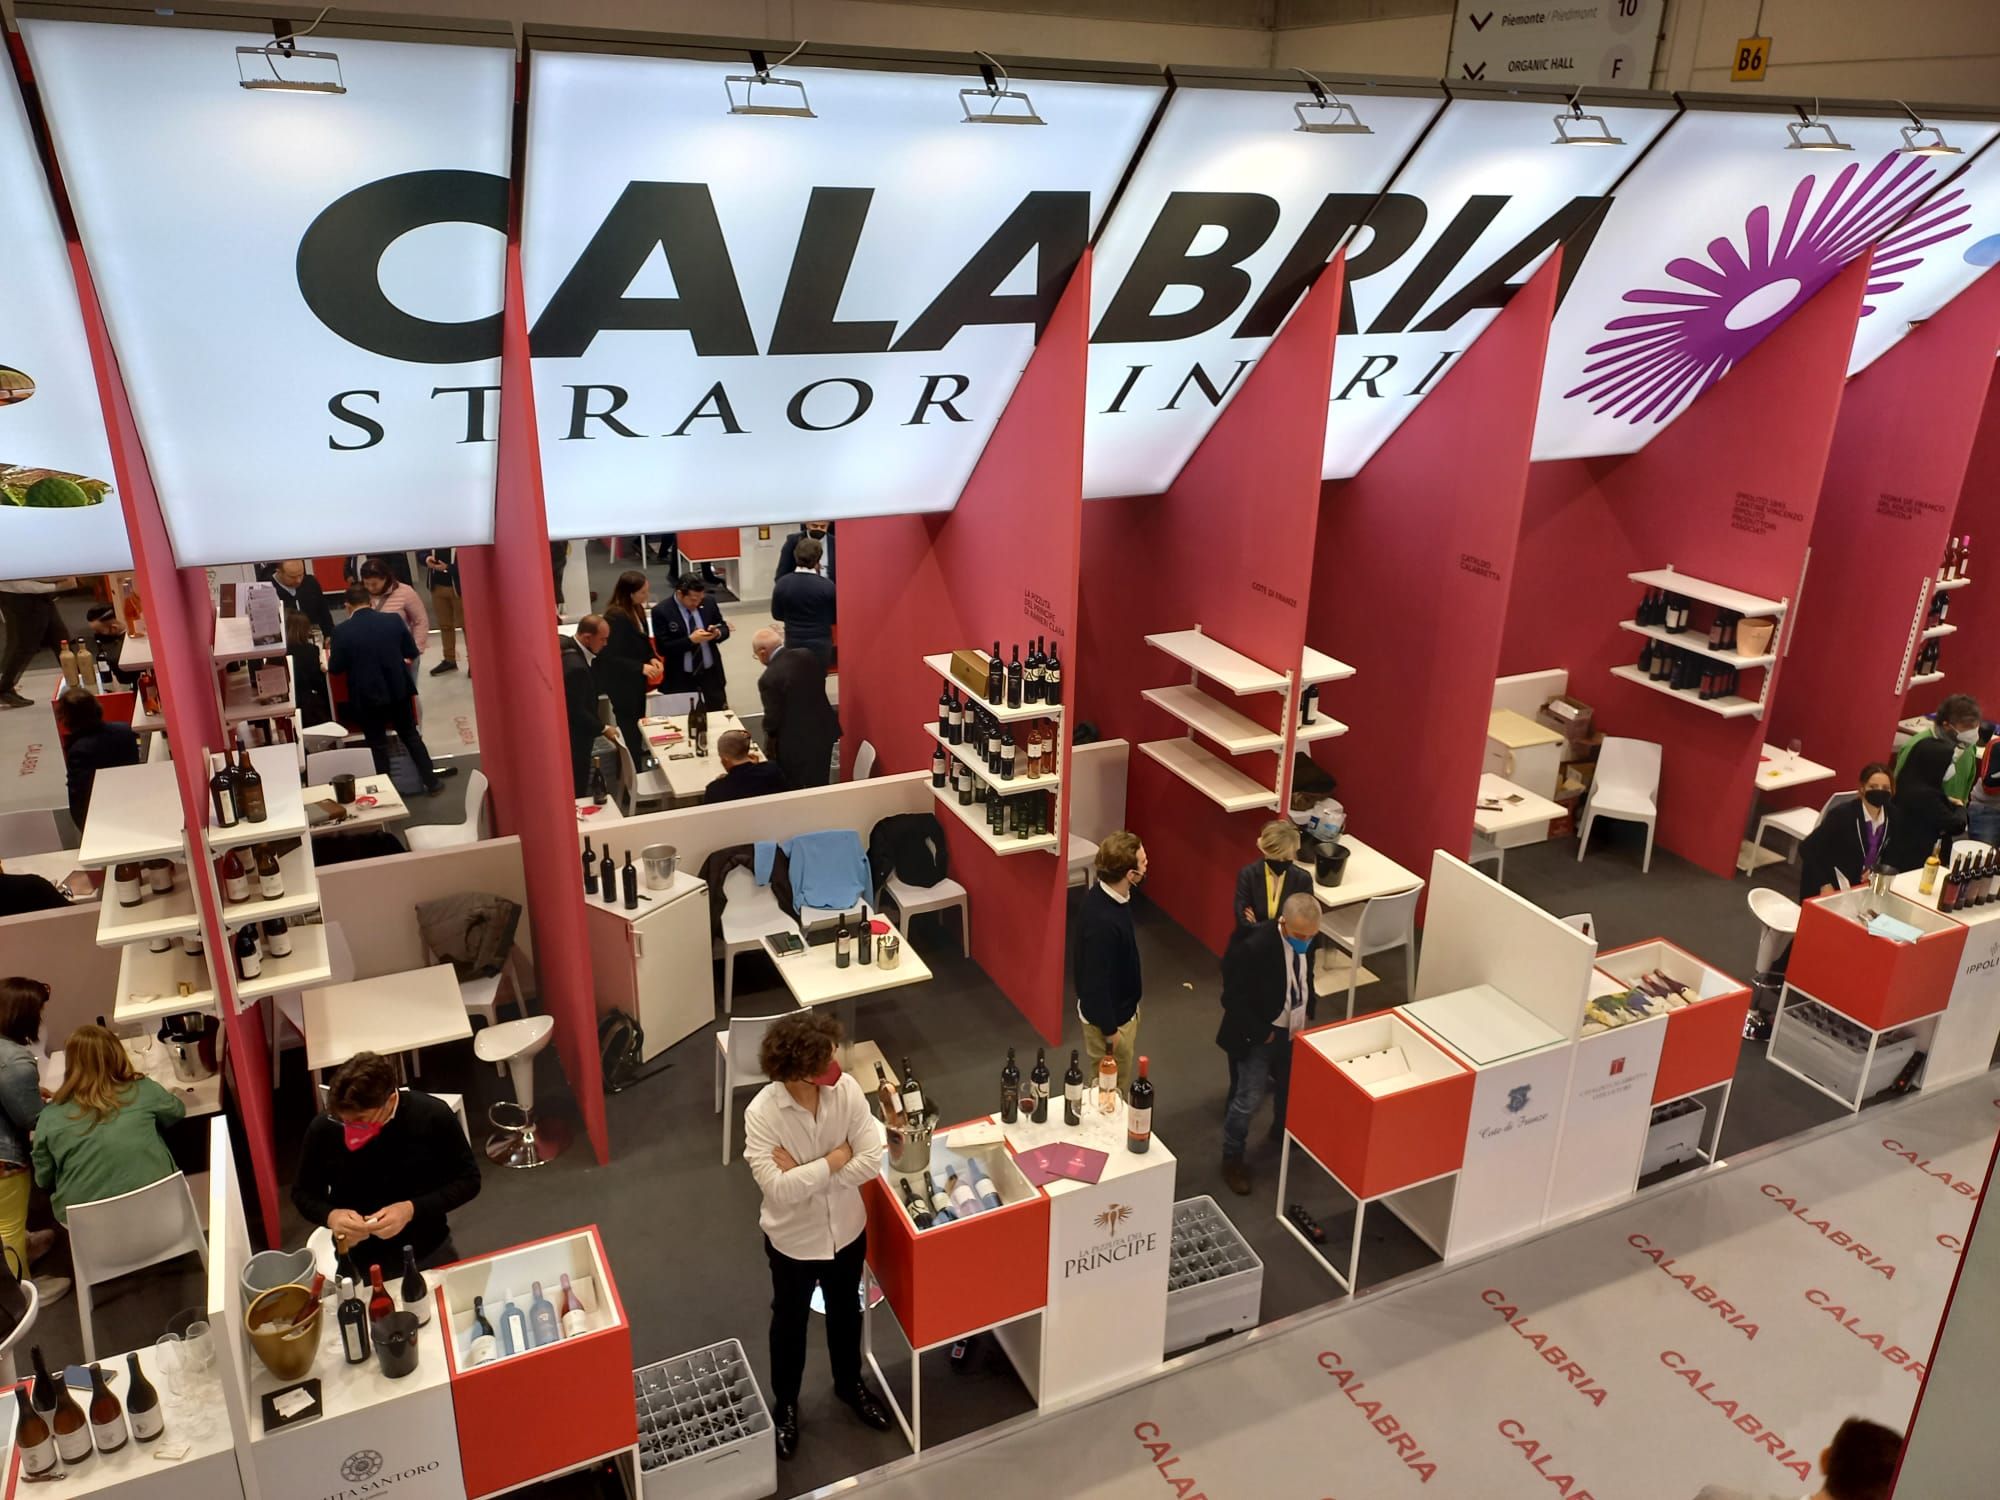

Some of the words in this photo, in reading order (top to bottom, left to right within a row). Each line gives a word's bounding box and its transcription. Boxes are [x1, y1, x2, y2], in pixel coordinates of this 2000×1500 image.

[1501, 12, 1545, 26] Piemonte
[1551, 8, 1598, 21] Piedmont
[1618, 0, 1637, 17] 10
[1737, 48, 1762, 73] B6
[1508, 59, 1549, 72] ORGANIC
[1551, 57, 1574, 69] HALL
[1611, 59, 1623, 79] F
[296, 169, 1615, 364] CALABRIA
[327, 350, 1462, 450] STRAORINRI
[1064, 1232, 1157, 1279] PRINCIPE
[1761, 1184, 1896, 1280] CALABRIA
[1628, 1233, 1760, 1341] CALABRIA
[1482, 1288, 1608, 1407] CALABRIA
[1805, 1289, 1927, 1382] CALABR
[1318, 1351, 1438, 1484] CALABRIA
[1660, 1350, 1812, 1482] CALABRIA
[360, 1460, 440, 1492] SANTORO
